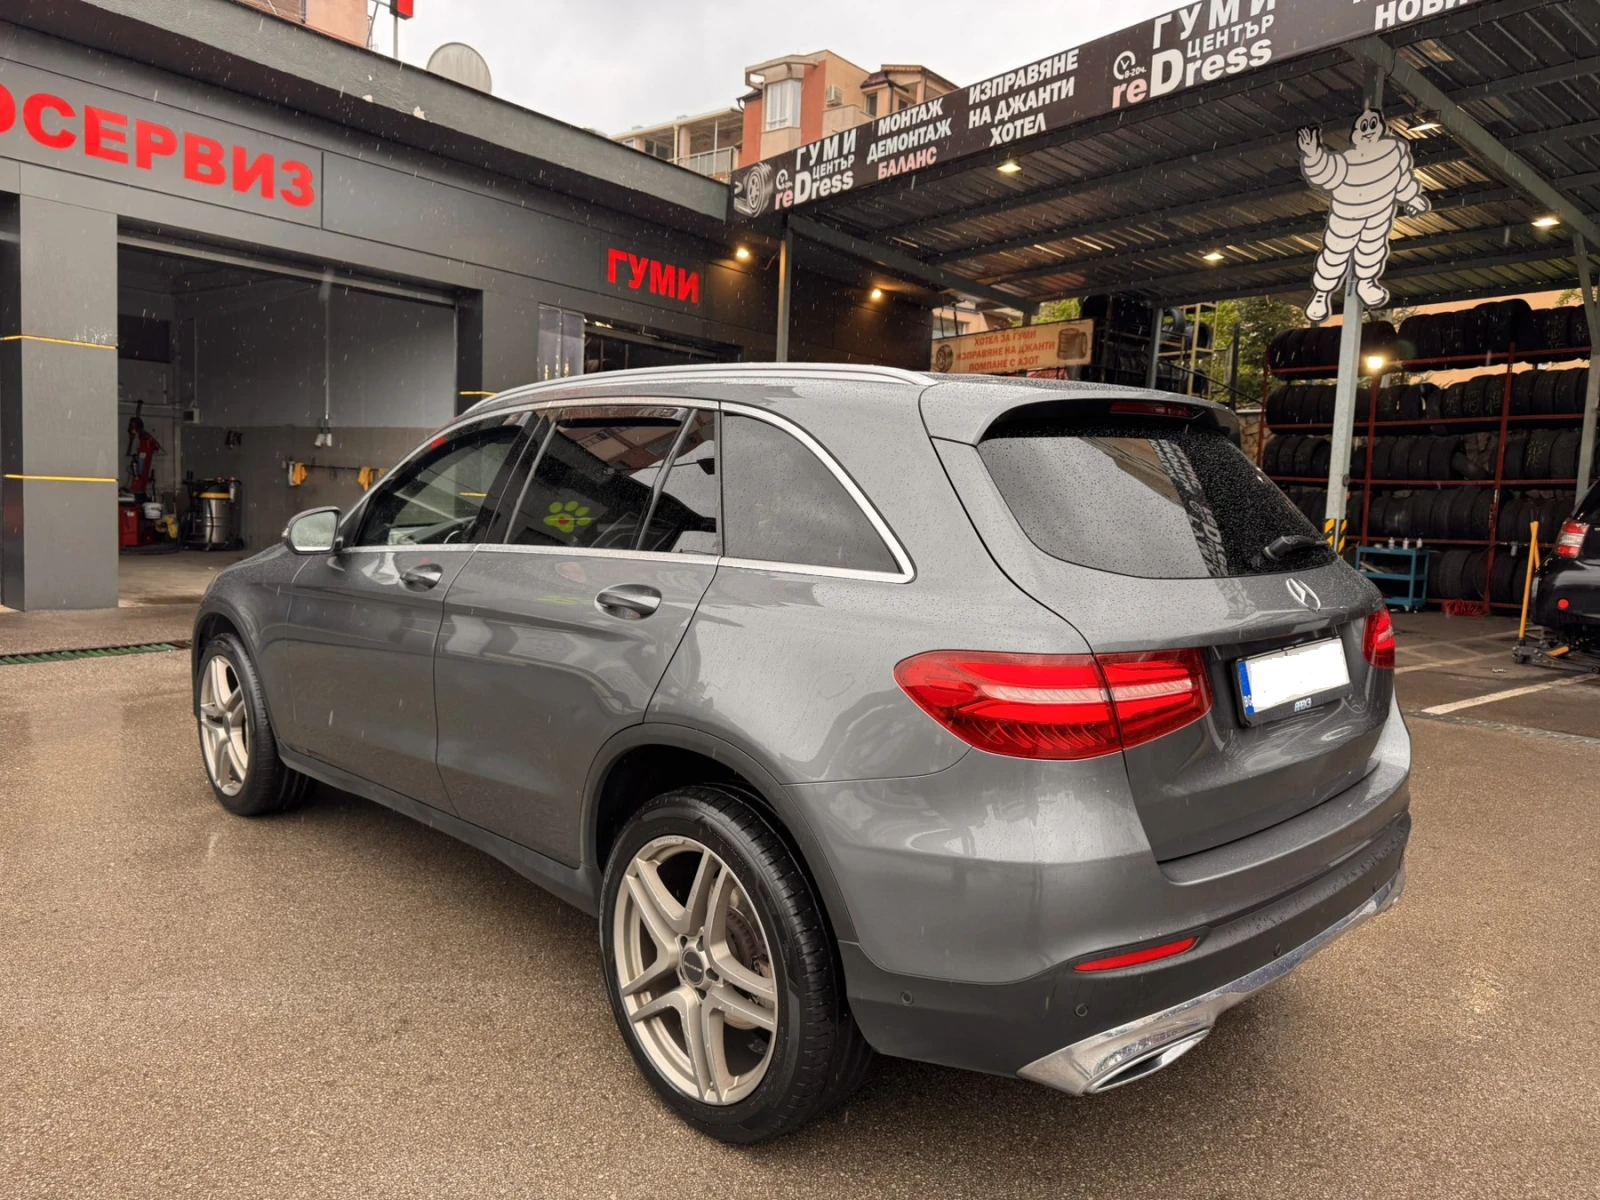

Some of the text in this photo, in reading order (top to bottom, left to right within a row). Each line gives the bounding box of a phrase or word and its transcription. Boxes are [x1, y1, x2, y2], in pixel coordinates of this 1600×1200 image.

[1187, 14, 1274, 59] ЦЕНТЪР
[968, 48, 1079, 105] ИЗПРАВЯНЕ
[1112, 39, 1272, 109] reDress
[878, 98, 944, 137] МОНТАЖ
[968, 76, 1075, 130] НА ДЖАНТИ
[0, 83, 315, 208] СЕРВИЗ
[795, 128, 857, 172] ГУМИ
[866, 118, 952, 164] ДЕМОНТАЖ
[989, 112, 1047, 147] ХОТЕЛ
[812, 154, 855, 181] ЦЕНТЪР
[877, 146, 937, 180] БАЛАНС
[774, 170, 854, 210] reDress
[607, 248, 699, 304] ГУМИ
[956, 340, 1056, 361] ИЗПРАВЯНЕ НА ДЖАНТИ
[974, 330, 1037, 346] ХОТЕЛ ЗА ГУМИ
[968, 355, 1039, 372] ПОМПАНЕ С АЗОТ
